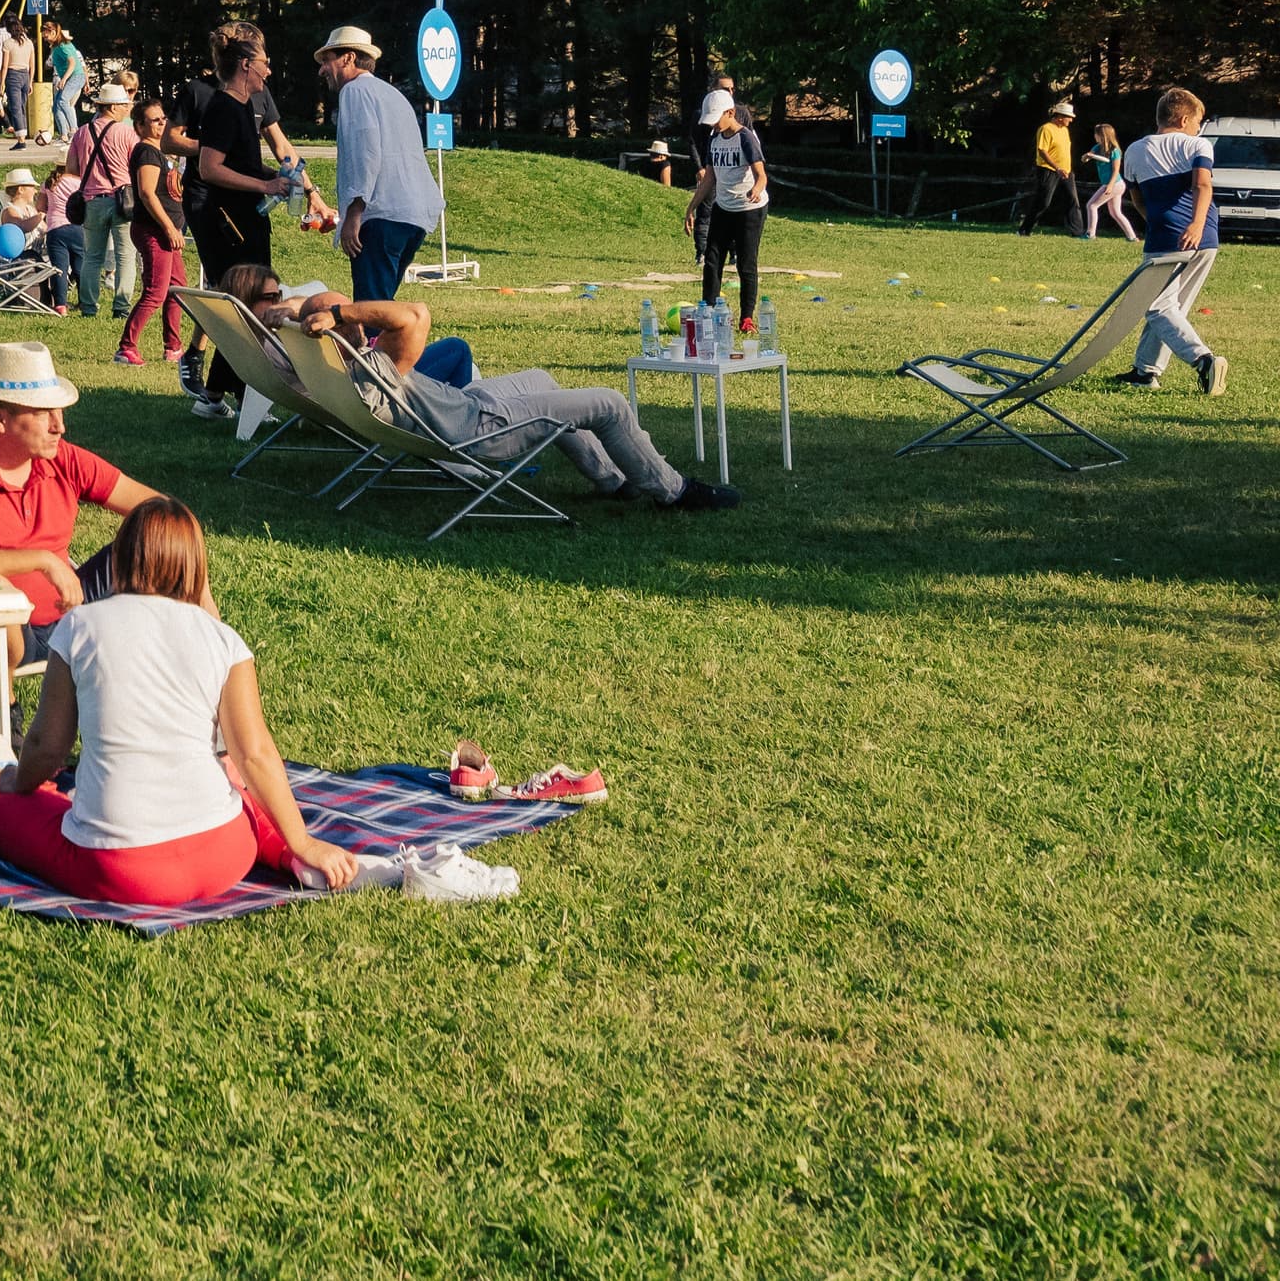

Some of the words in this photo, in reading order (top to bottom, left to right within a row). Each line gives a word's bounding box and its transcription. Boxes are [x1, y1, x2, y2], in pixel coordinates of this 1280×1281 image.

[31, 0, 43, 8] WC
[422, 47, 456, 60] DACIA
[874, 72, 907, 82] DACIA
